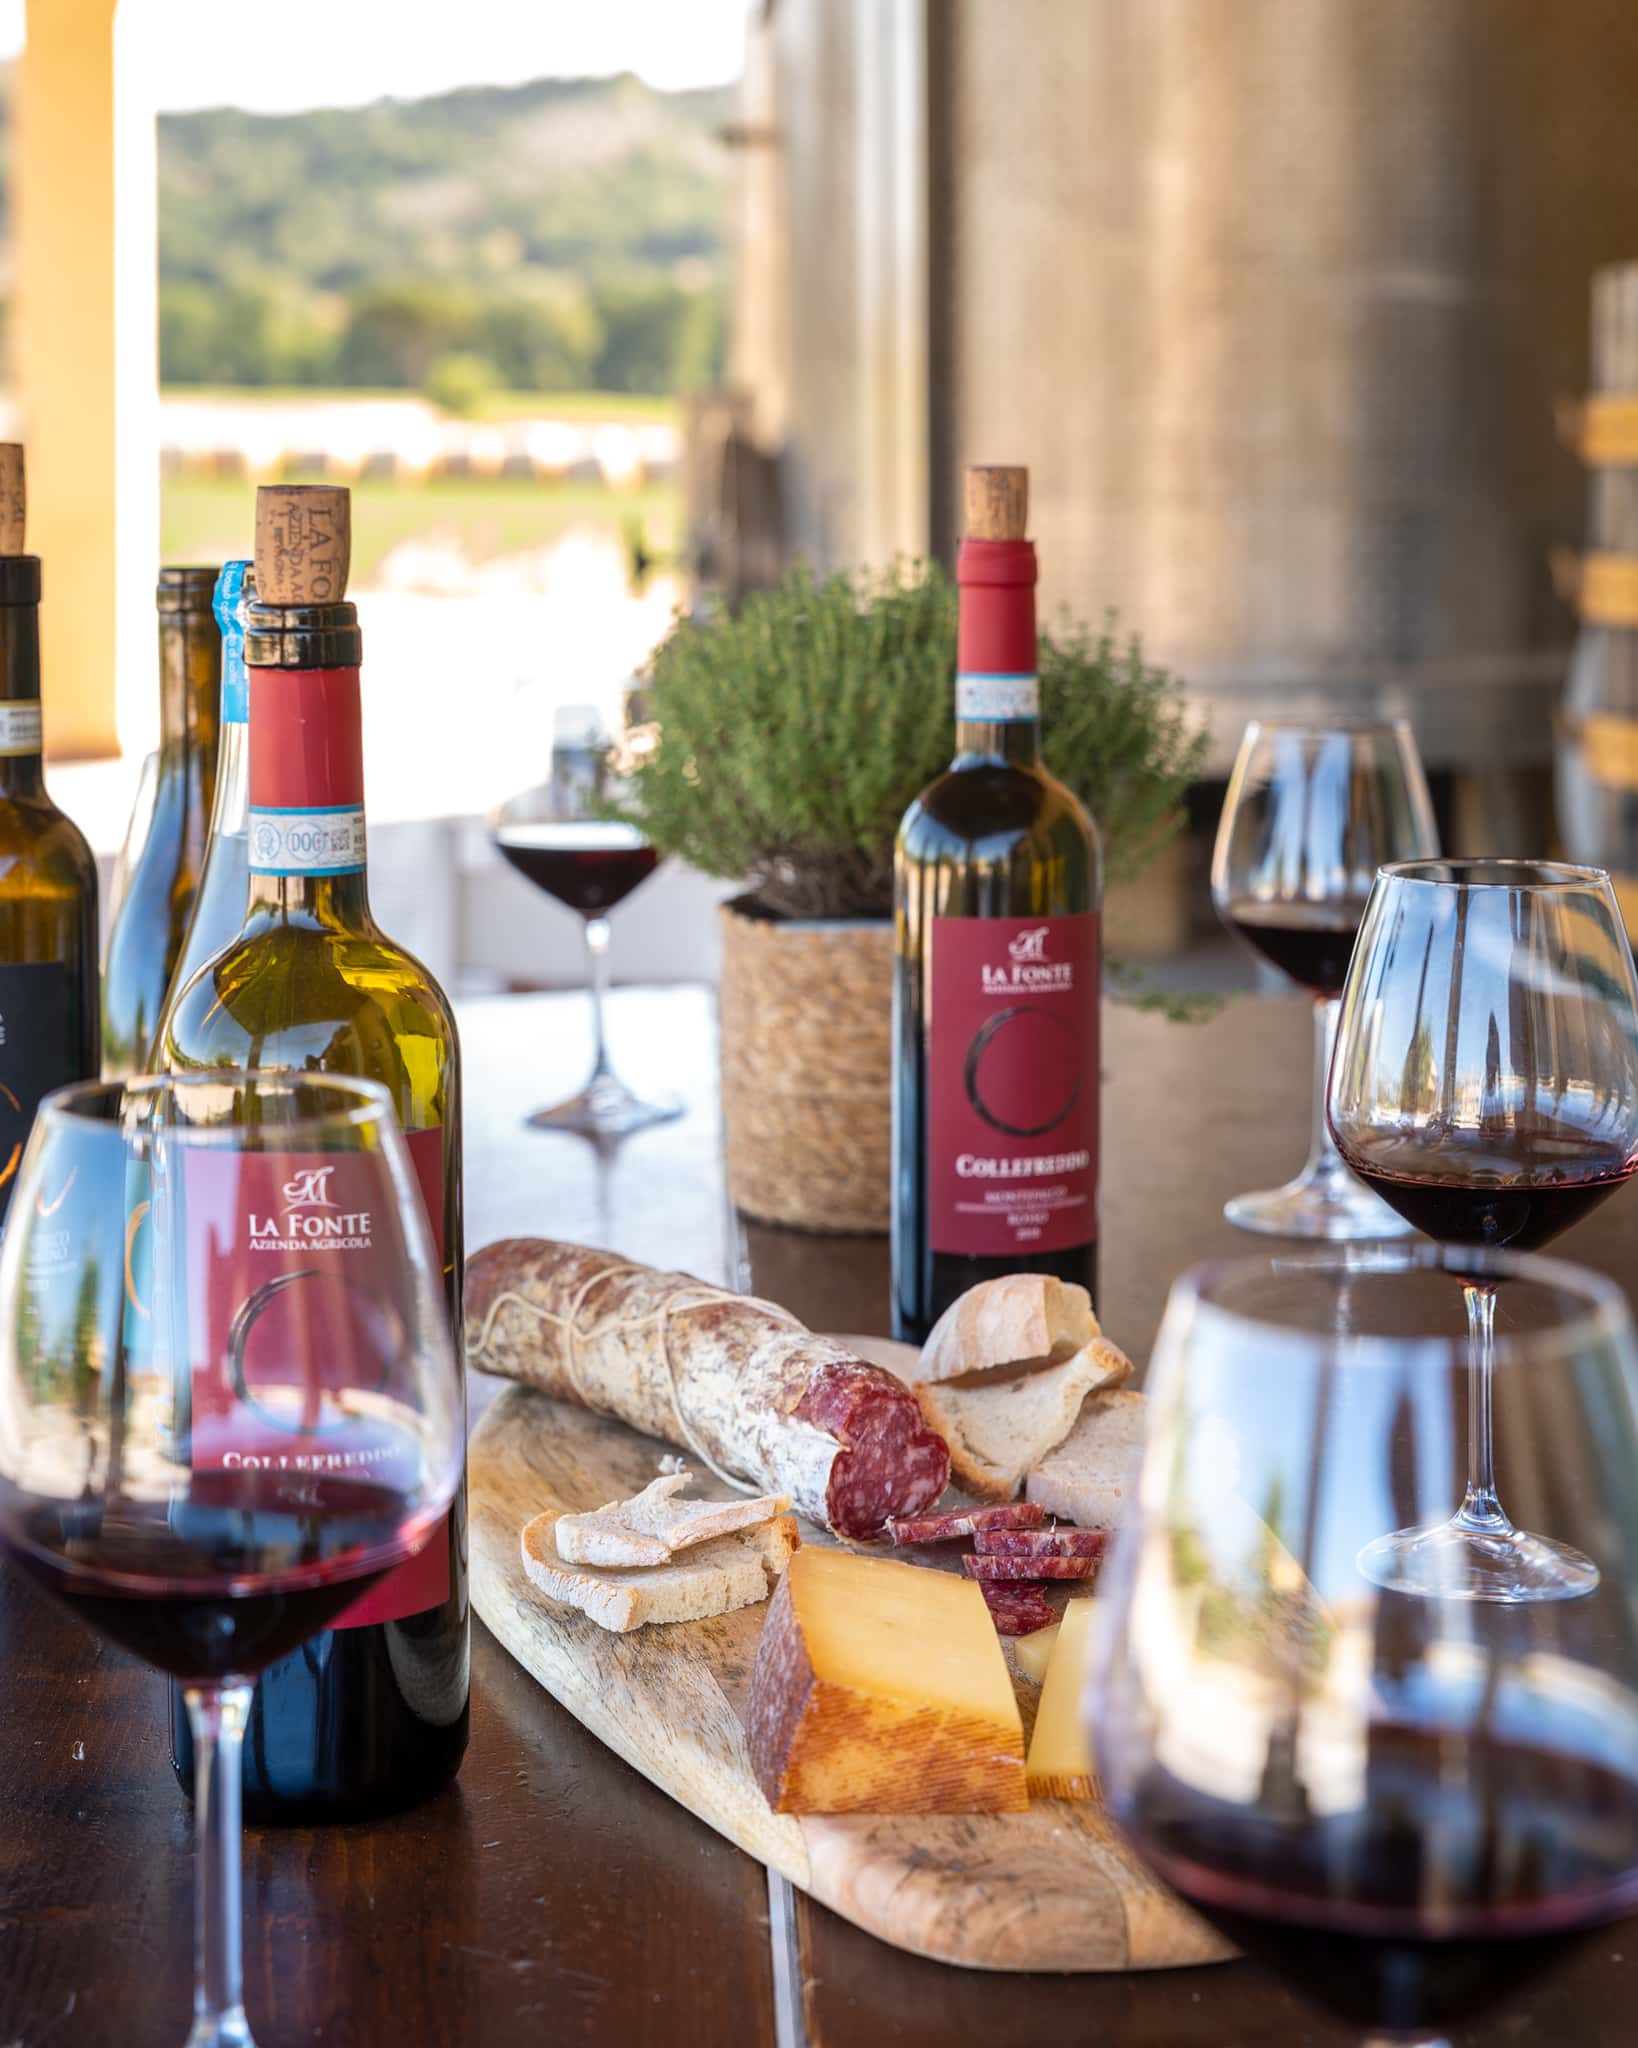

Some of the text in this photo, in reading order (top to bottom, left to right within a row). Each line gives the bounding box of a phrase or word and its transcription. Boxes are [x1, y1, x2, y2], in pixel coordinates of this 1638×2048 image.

[308, 507, 332, 550] LA
[982, 962, 1072, 984] LA FONTE
[249, 1213, 371, 1237] LA FONTE
[249, 1237, 372, 1250] AZIENDA AGRICOLA
